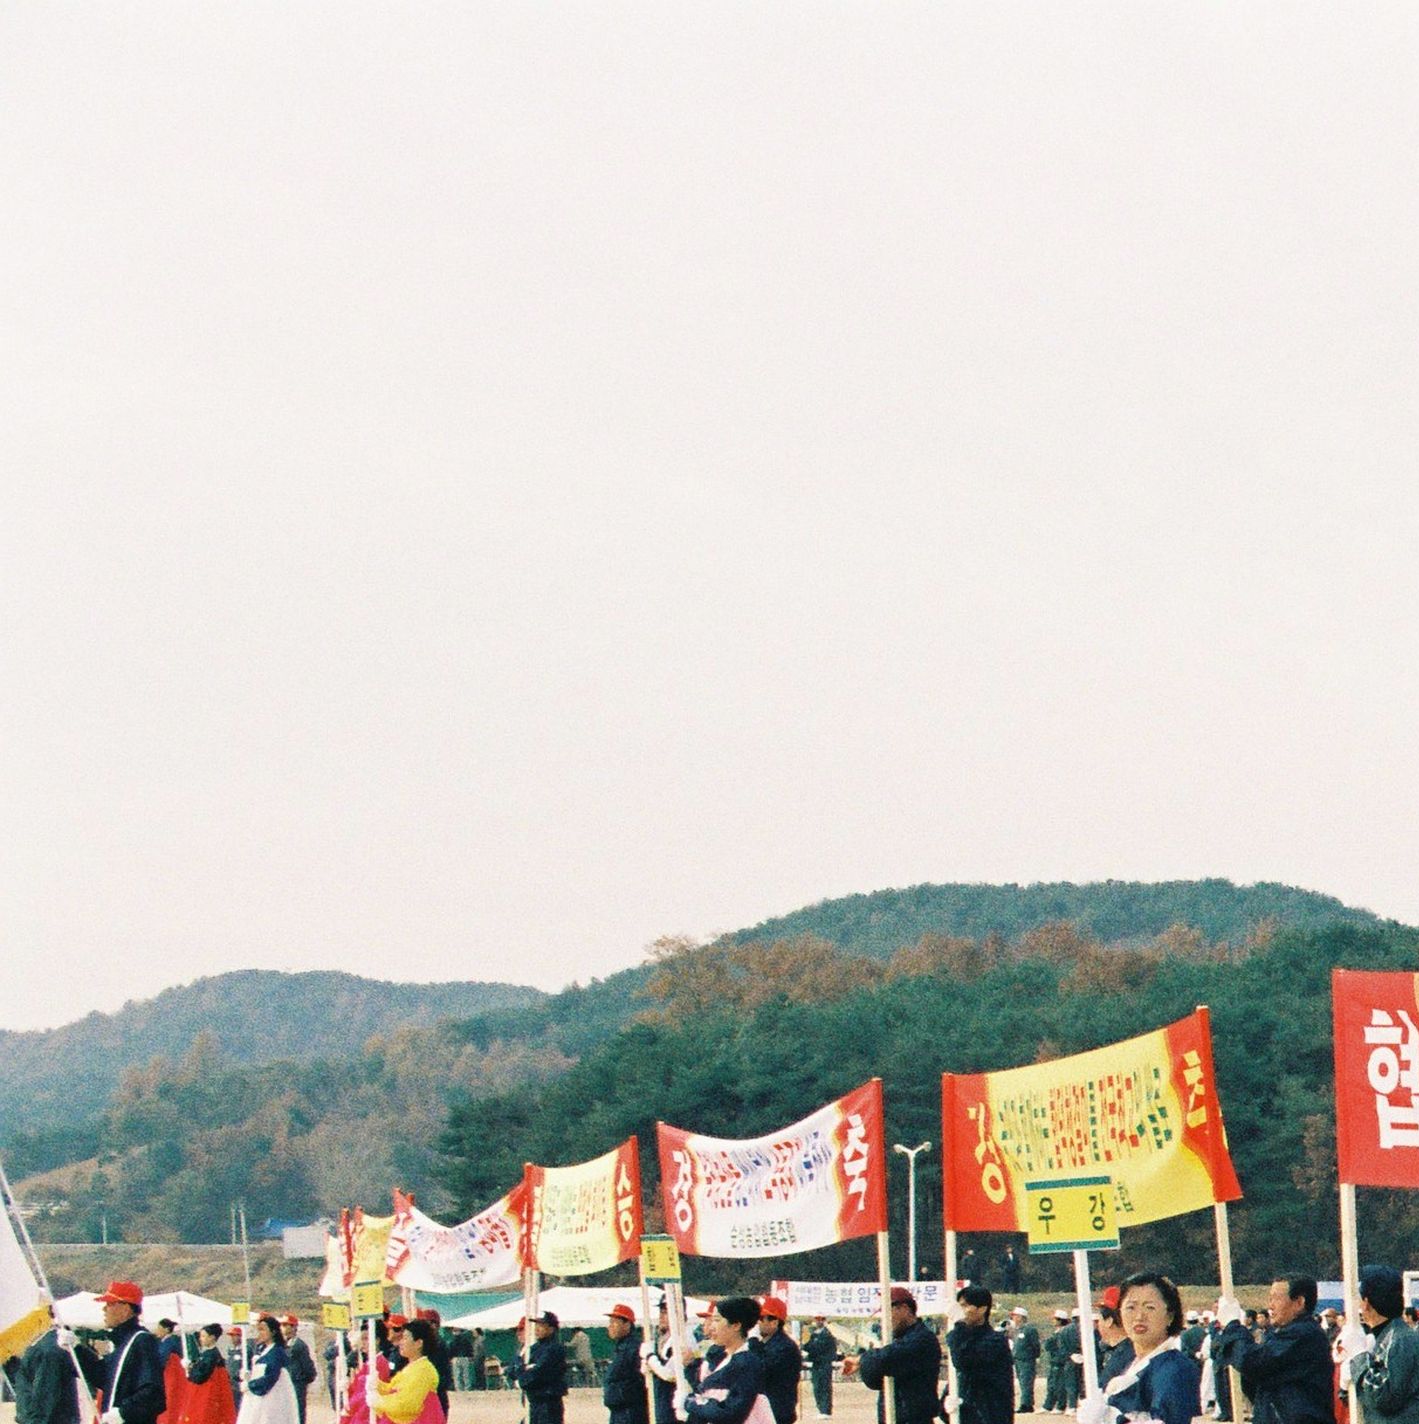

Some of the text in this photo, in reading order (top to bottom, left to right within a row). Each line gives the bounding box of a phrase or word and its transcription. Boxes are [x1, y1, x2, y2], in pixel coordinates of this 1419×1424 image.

[671, 1149, 693, 1233] 경
[843, 1113, 870, 1212] 축
[1038, 1191, 1106, 1236] 우강
